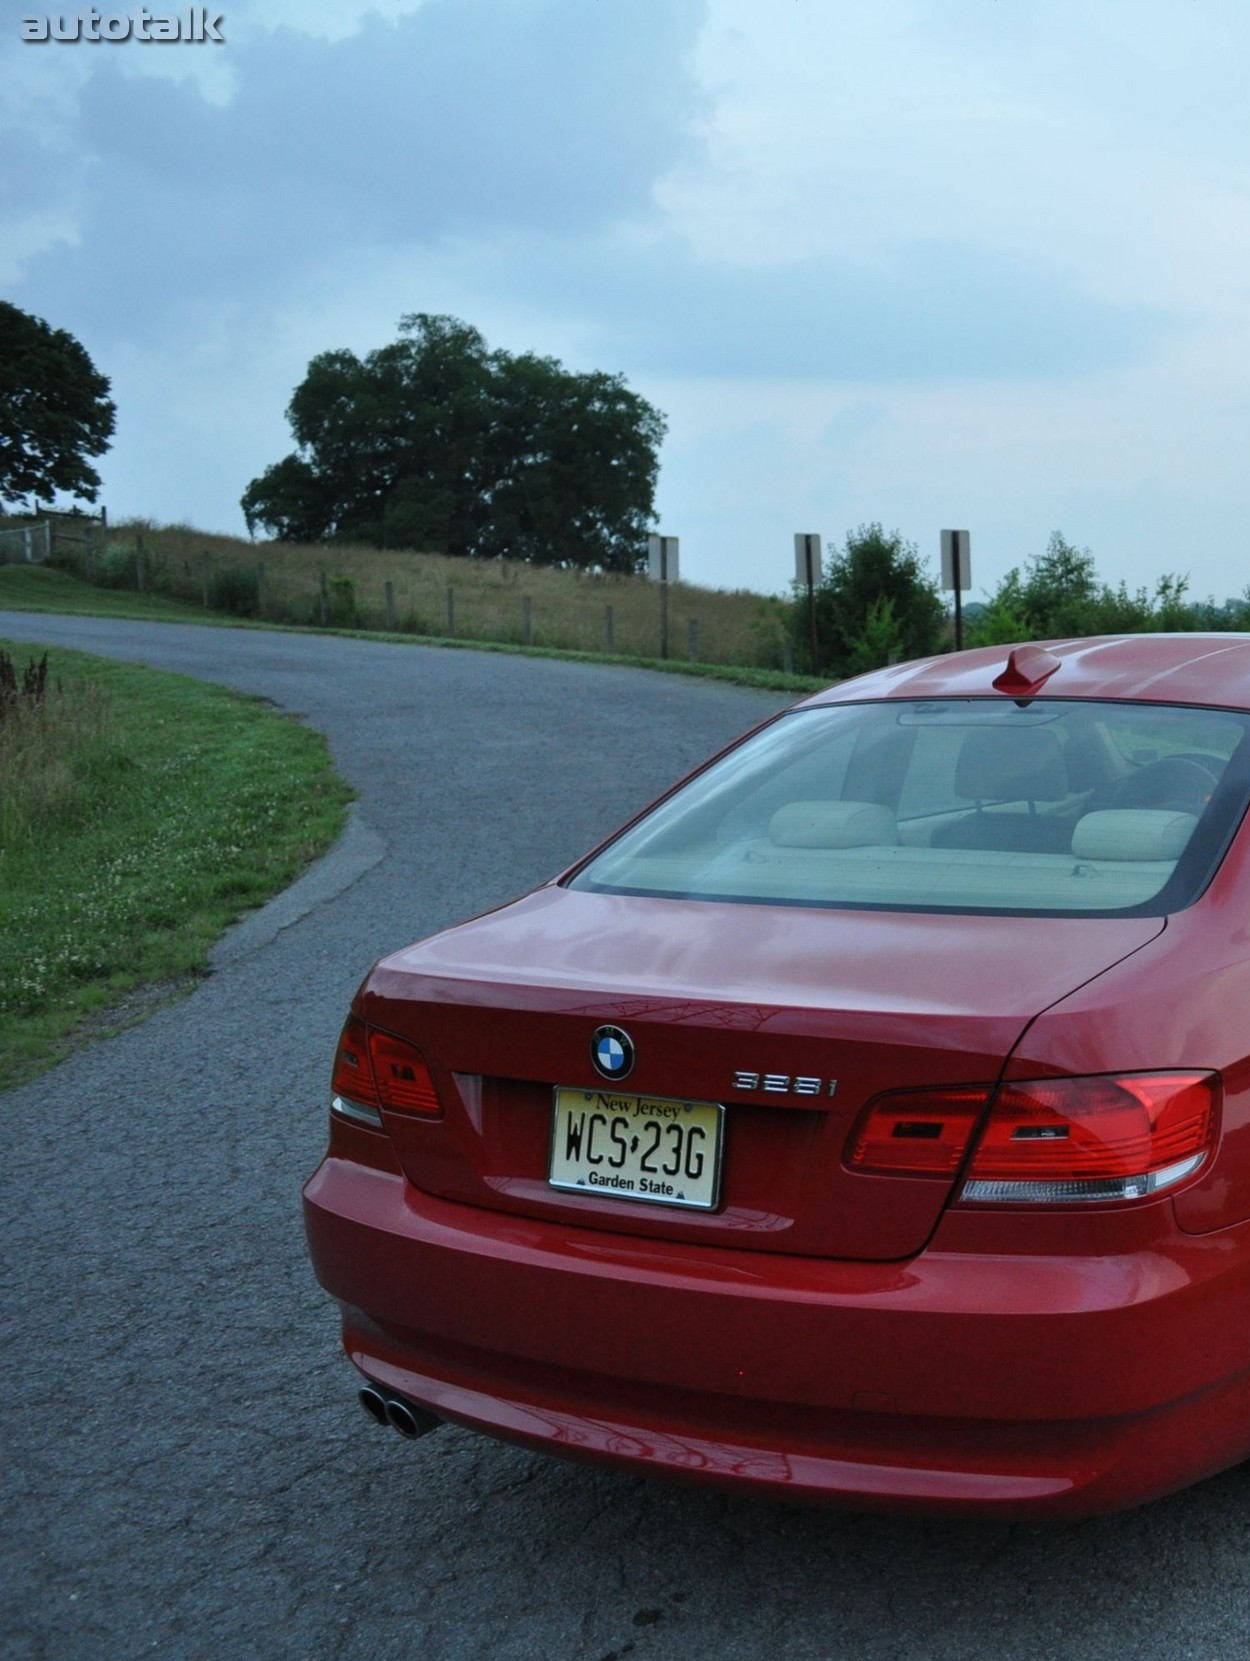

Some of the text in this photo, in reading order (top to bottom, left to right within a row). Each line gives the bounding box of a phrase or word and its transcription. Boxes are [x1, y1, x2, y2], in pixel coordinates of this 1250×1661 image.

[732, 1071, 838, 1097] 328i
[595, 1093, 681, 1121] New Jersey
[588, 1171, 674, 1195] Garden State
